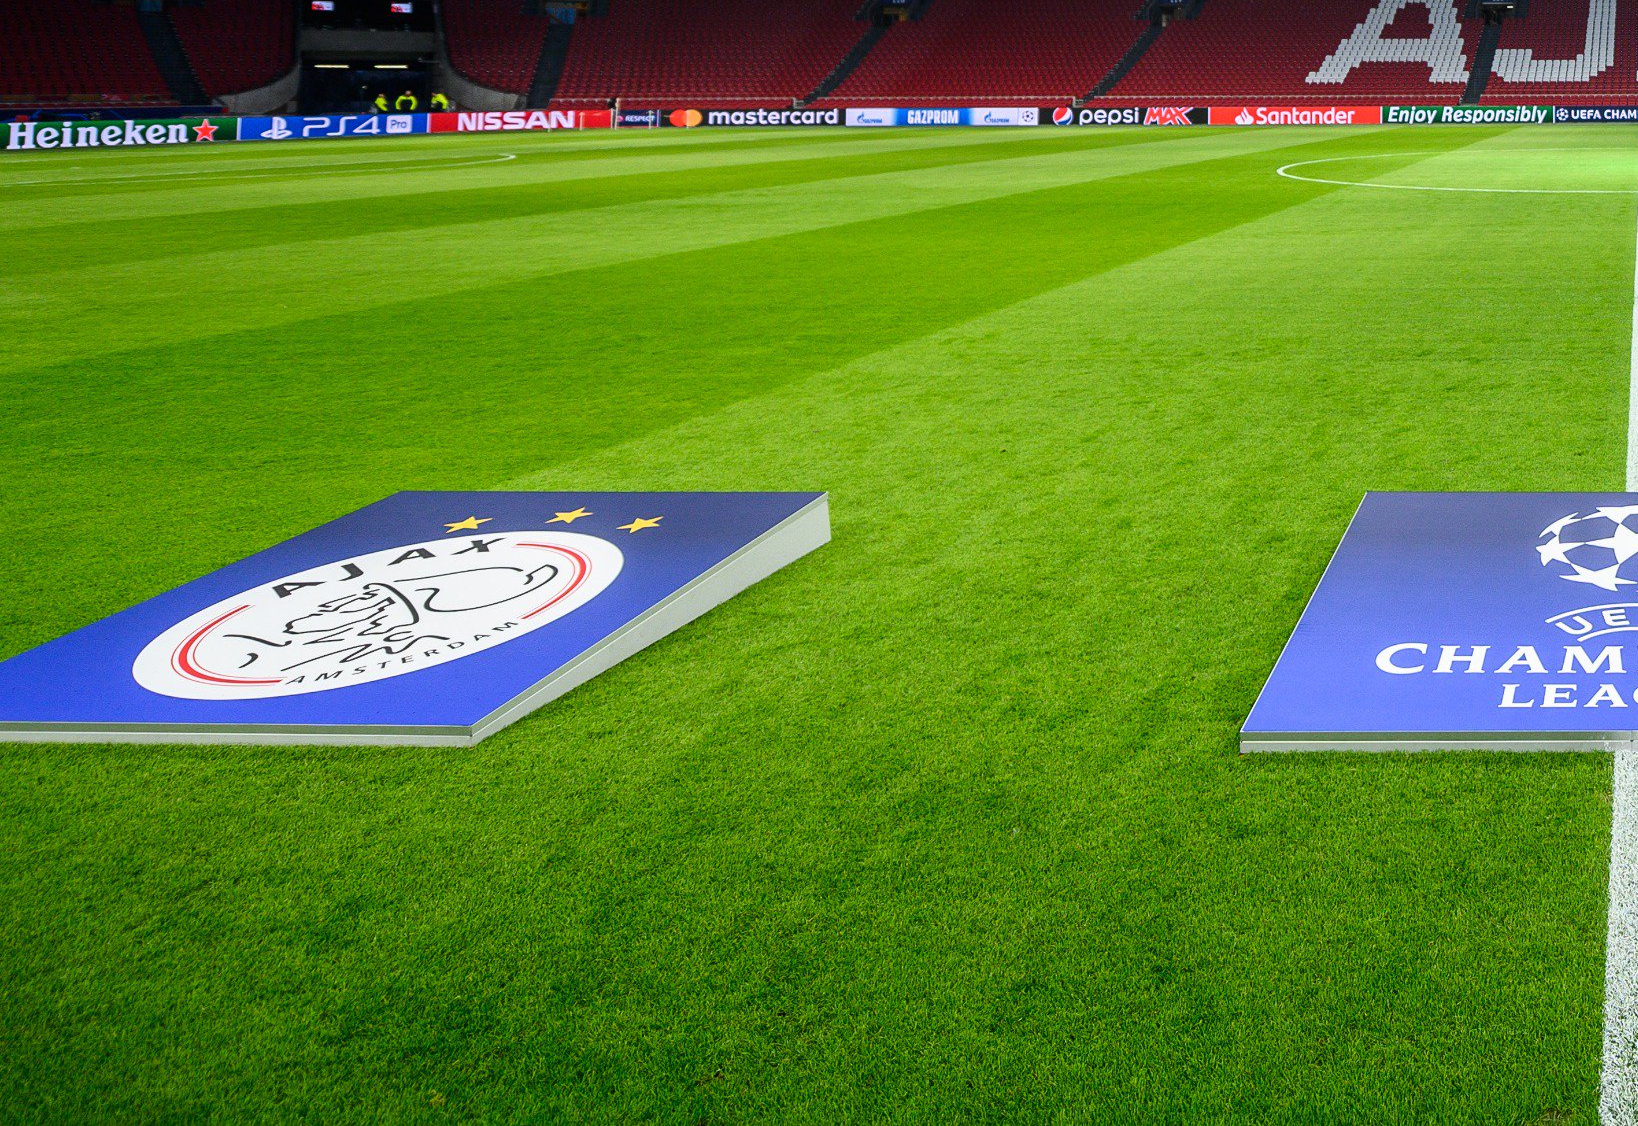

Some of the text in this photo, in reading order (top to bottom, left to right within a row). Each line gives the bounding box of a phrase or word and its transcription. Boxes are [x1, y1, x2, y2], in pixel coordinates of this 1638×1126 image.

[457, 110, 575, 132] NISSAN
[708, 108, 839, 125] mastercard
[907, 109, 959, 125] GAZPROM
[1078, 107, 1194, 125] pepsi MAX
[1255, 107, 1355, 125] Santander
[1387, 106, 1548, 124] Enjoy Responsibly
[1571, 109, 1601, 120] UEFA
[6, 119, 190, 151] Heineken
[302, 116, 408, 137] PS4 Pro
[272, 537, 507, 600] AJAX
[283, 621, 520, 686] AMSTERDAM
